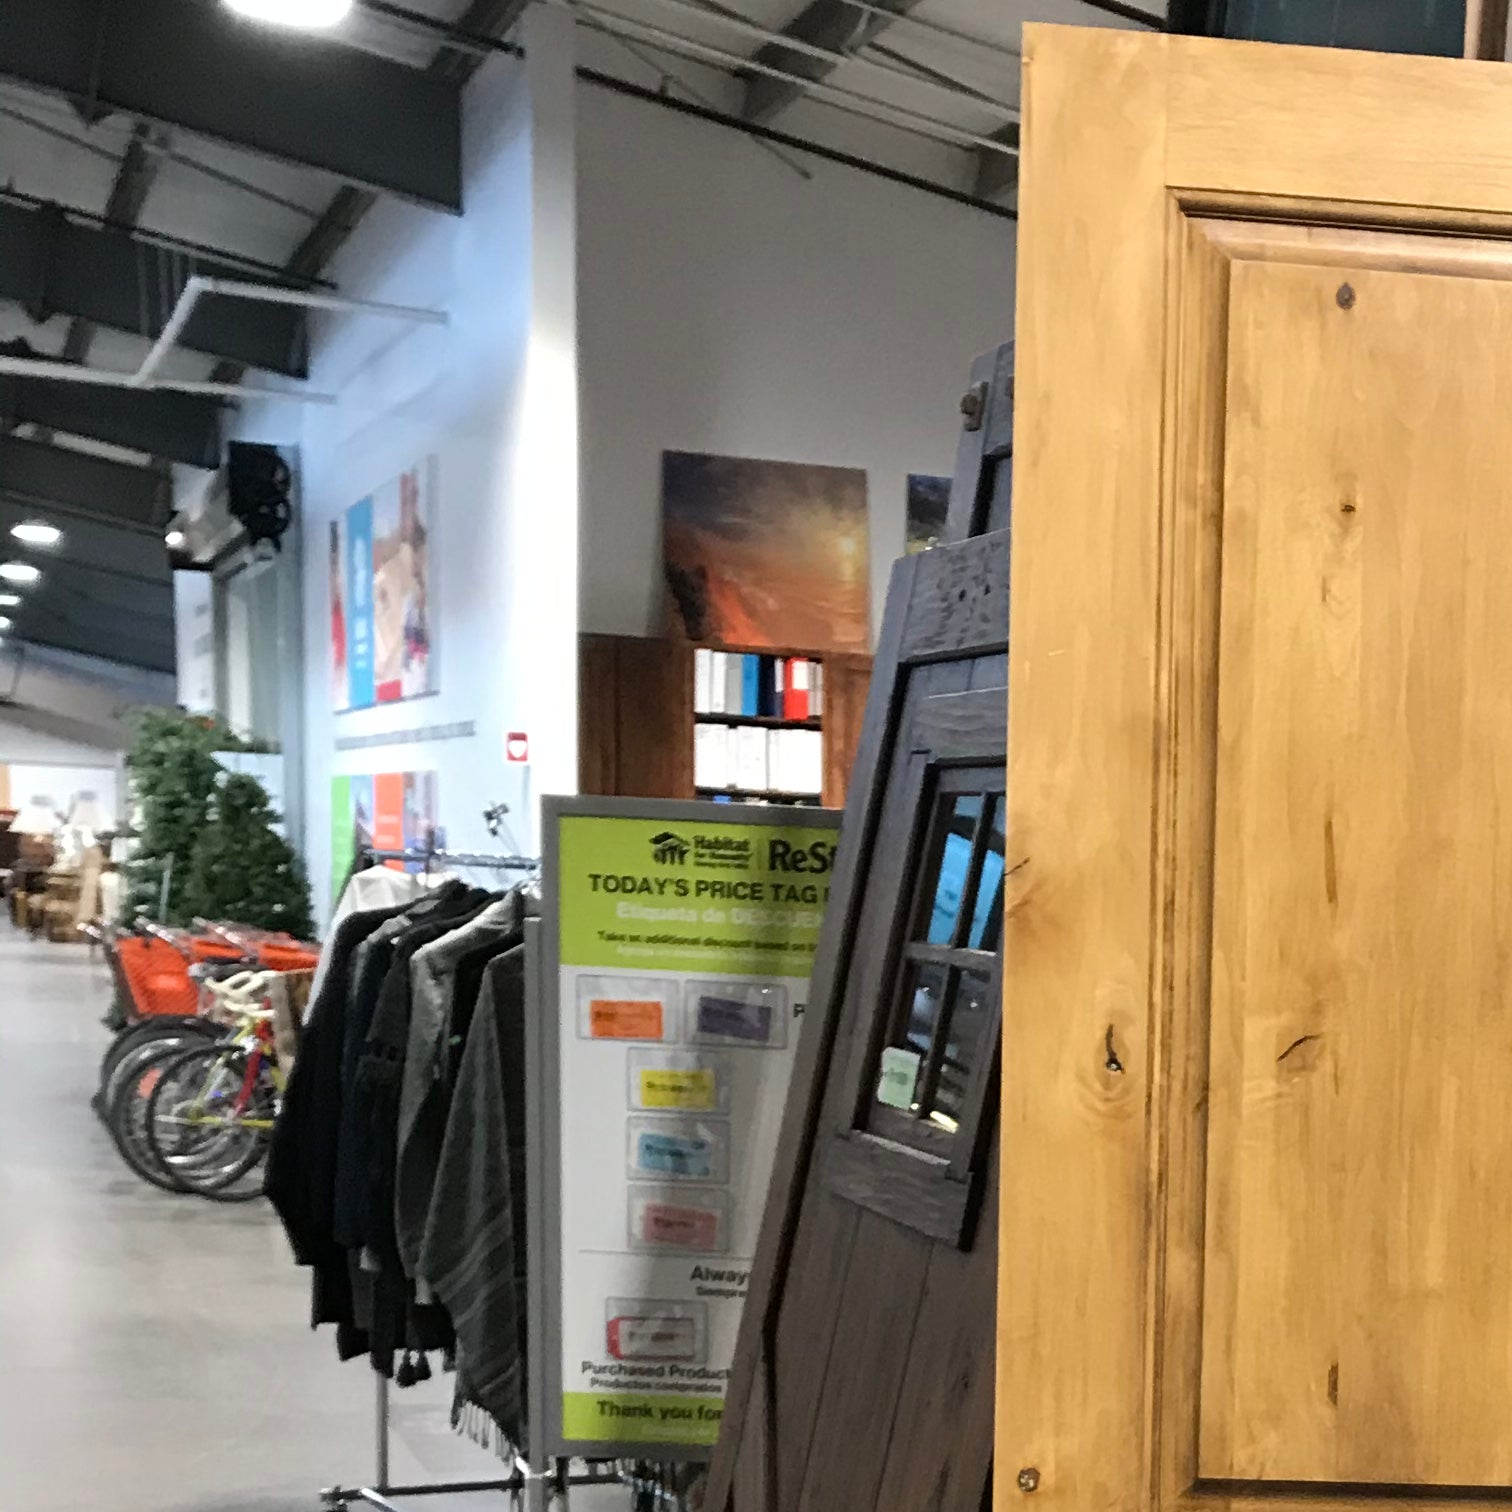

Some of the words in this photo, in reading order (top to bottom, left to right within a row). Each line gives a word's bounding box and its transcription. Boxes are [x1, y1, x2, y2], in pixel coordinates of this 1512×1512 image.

[693, 835, 750, 852] Habitat
[588, 873, 689, 898] TODAY'S
[695, 879, 763, 901] PRICE
[769, 883, 818, 904] TAG
[581, 1361, 665, 1378] Purchased
[597, 1400, 653, 1418] Thank
[659, 1406, 693, 1420] you
